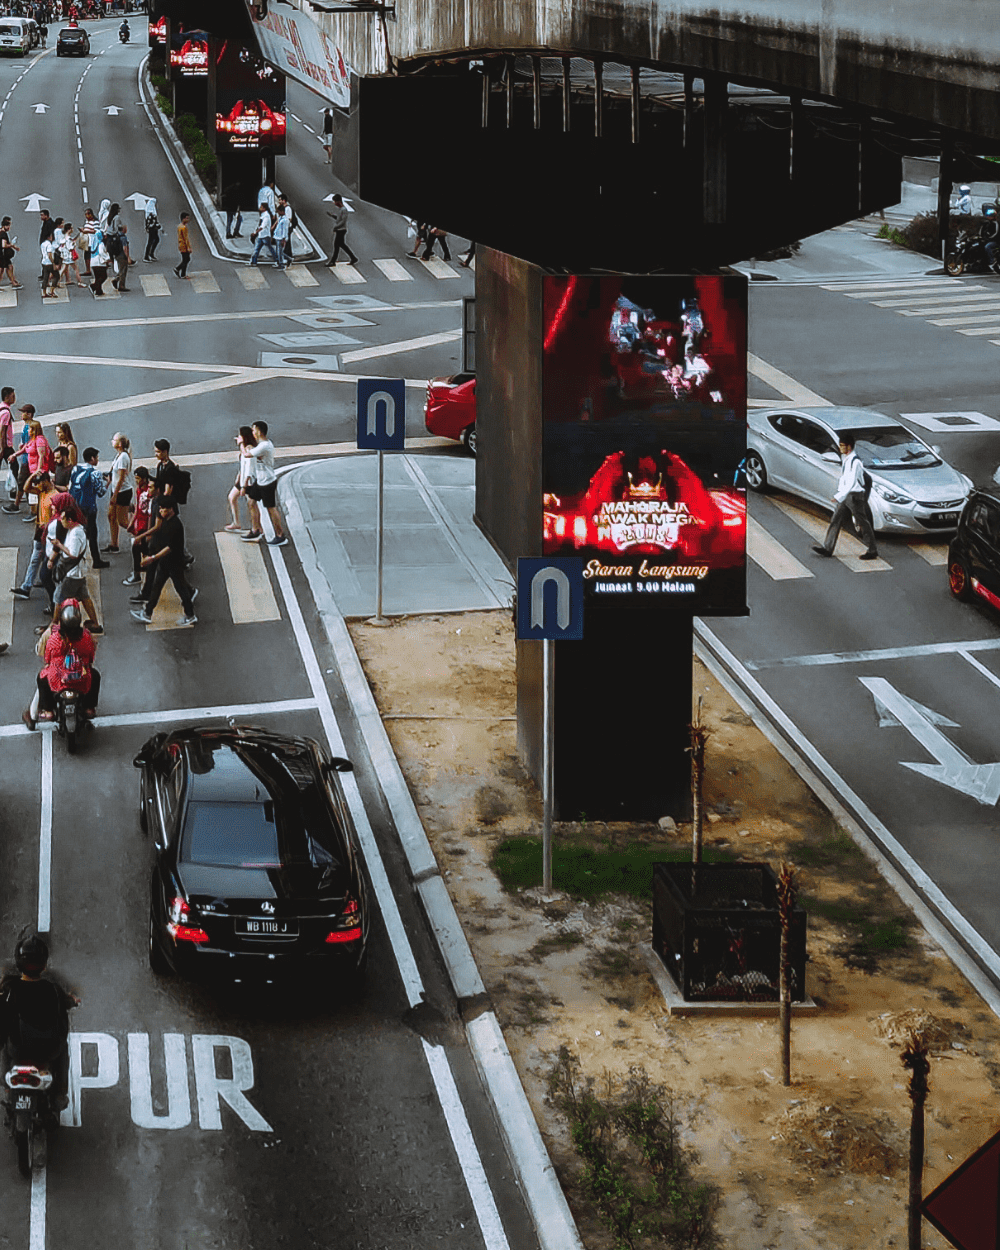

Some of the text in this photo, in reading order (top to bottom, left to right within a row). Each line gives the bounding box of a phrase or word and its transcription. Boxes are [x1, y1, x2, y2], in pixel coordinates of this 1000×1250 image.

[582, 559, 709, 579] Siaran Langsung
[661, 581, 696, 592] Malam
[246, 920, 260, 932] WB
[281, 922, 287, 933] J
